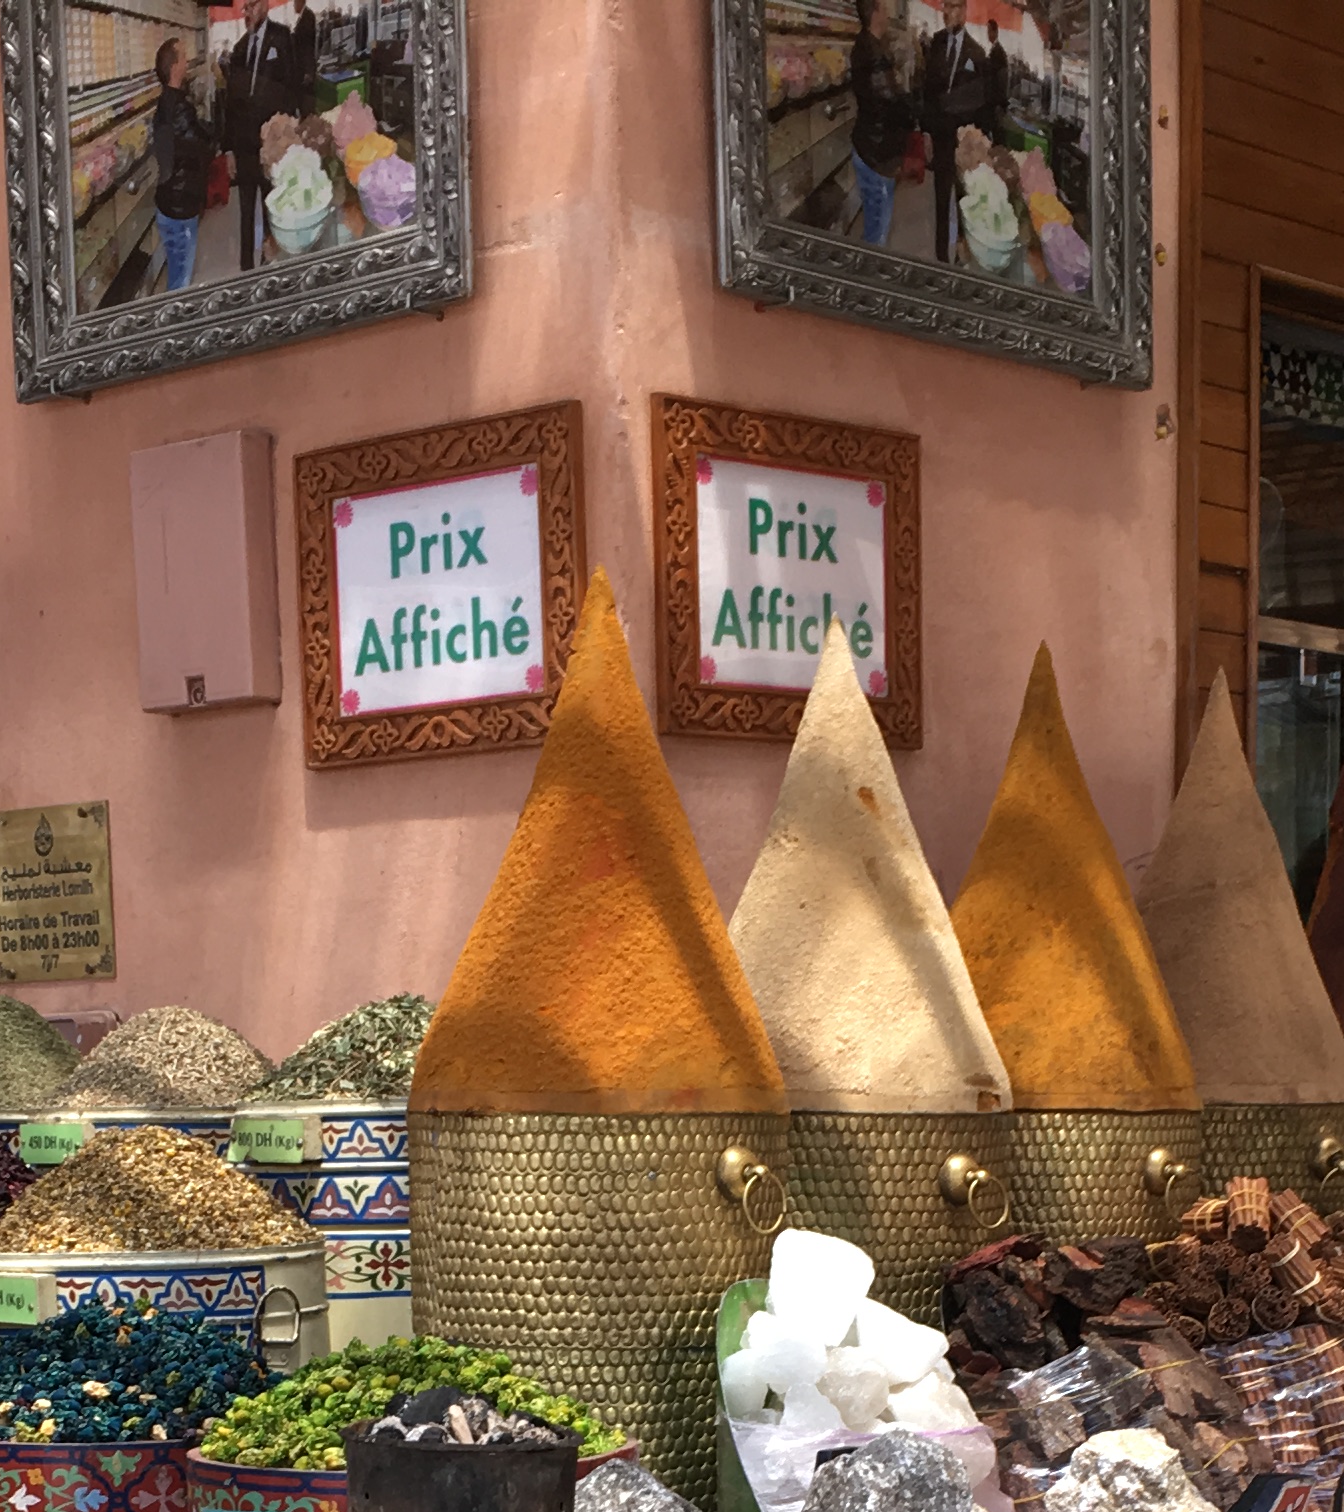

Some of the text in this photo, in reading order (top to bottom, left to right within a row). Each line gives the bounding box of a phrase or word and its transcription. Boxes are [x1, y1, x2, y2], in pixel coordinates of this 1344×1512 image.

[748, 498, 838, 563] Prix
[389, 512, 488, 579] Prix
[354, 596, 530, 677] Affiché
[2, 882, 61, 902] Herboristerie
[42, 912, 58, 929] de
[60, 909, 100, 928] Travail
[0, 935, 18, 953] De
[52, 932, 60, 950] à
[62, 929, 100, 949] 23h00
[44, 1136, 57, 1149] DH
[256, 1132, 272, 1147] DH
